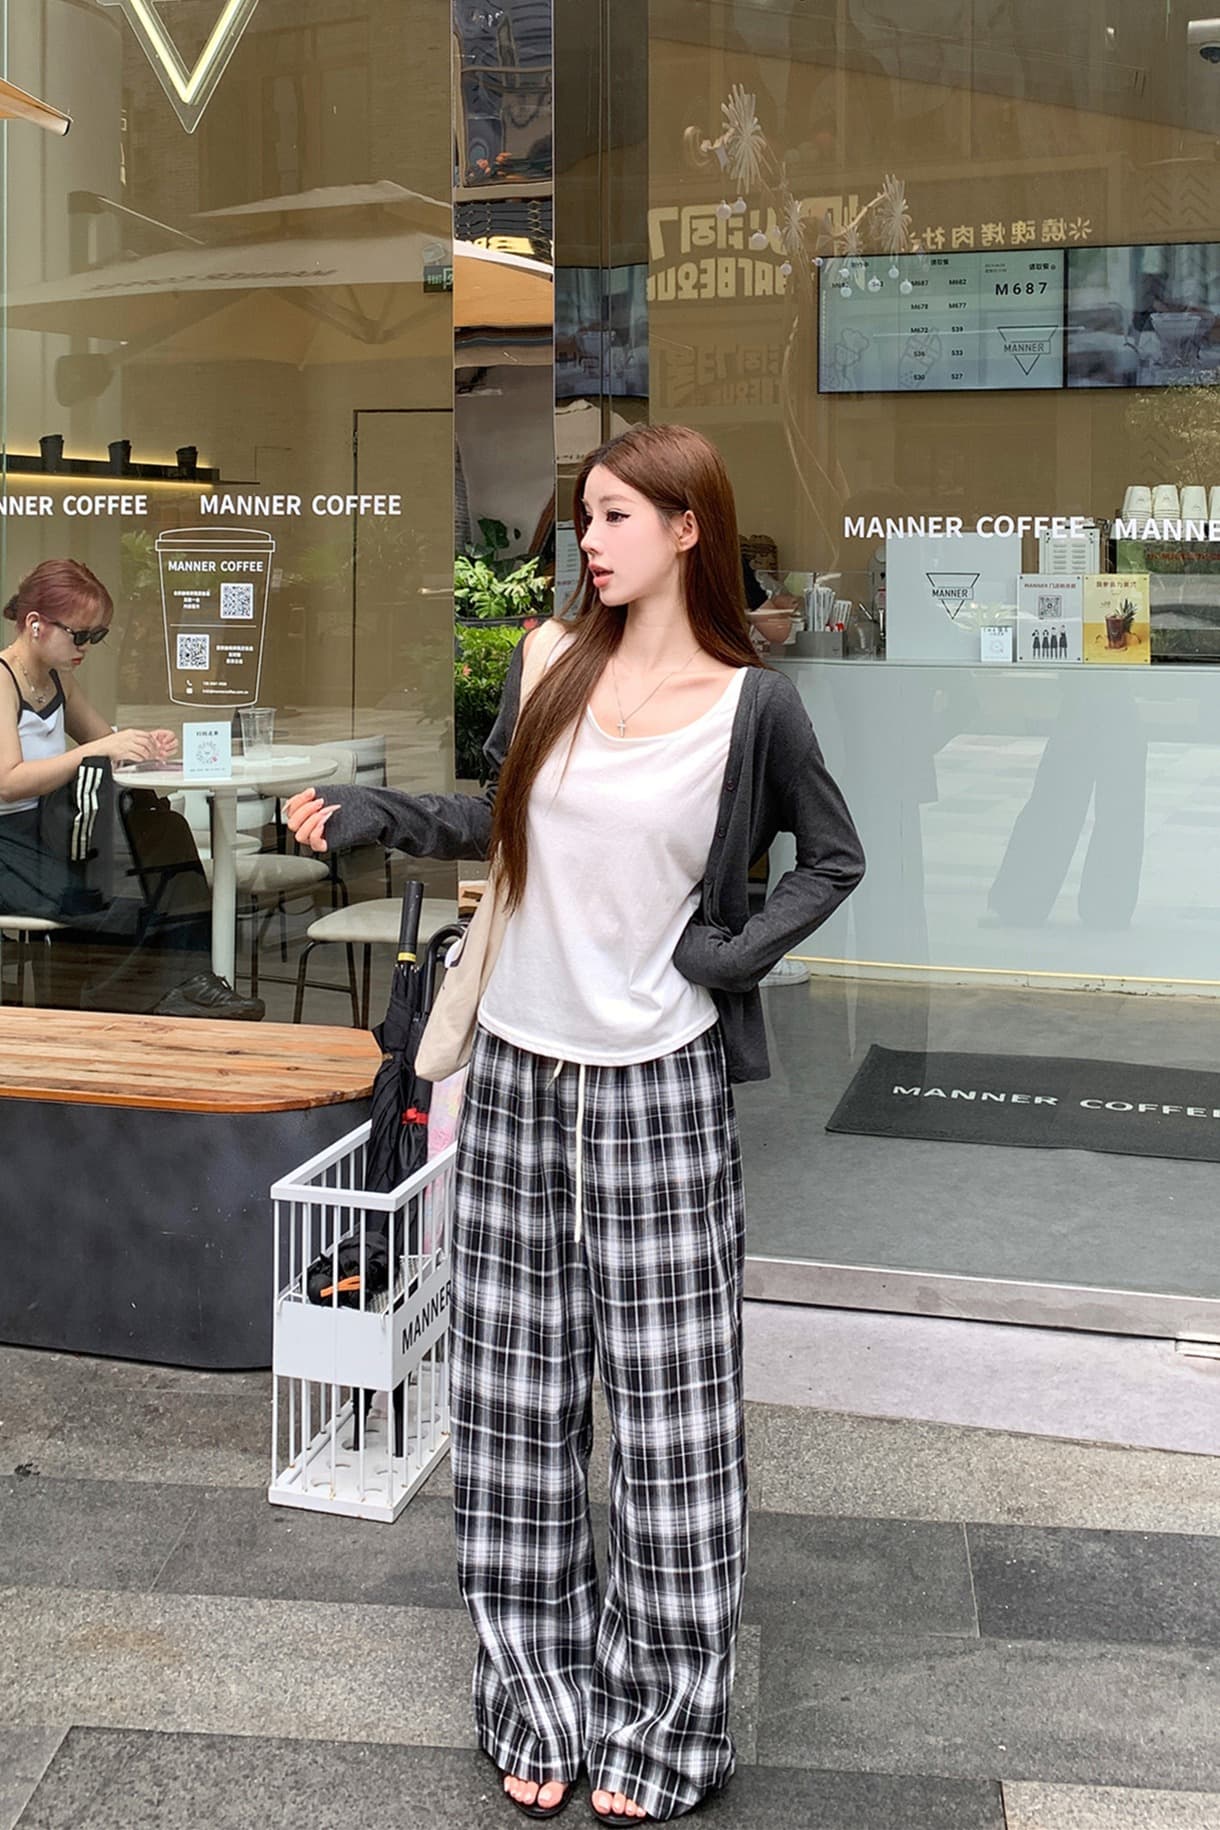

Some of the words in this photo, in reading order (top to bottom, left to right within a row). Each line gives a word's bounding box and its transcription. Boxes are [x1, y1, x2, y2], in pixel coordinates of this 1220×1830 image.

[995, 282, 1048, 296] M687
[1004, 343, 1045, 353] MANNER
[63, 495, 148, 516] COFFEE
[200, 494, 301, 516] MANNER
[312, 494, 401, 516] COFFEE
[843, 515, 964, 539] MANNER
[976, 515, 1085, 539] COFFEE
[1114, 518, 1220, 542] MANNE
[168, 561, 217, 572] MANNER
[220, 561, 264, 572] COFFEE
[932, 589, 968, 598] MANNER
[893, 1084, 1060, 1106] MANNER
[402, 1279, 452, 1355] MANNER
